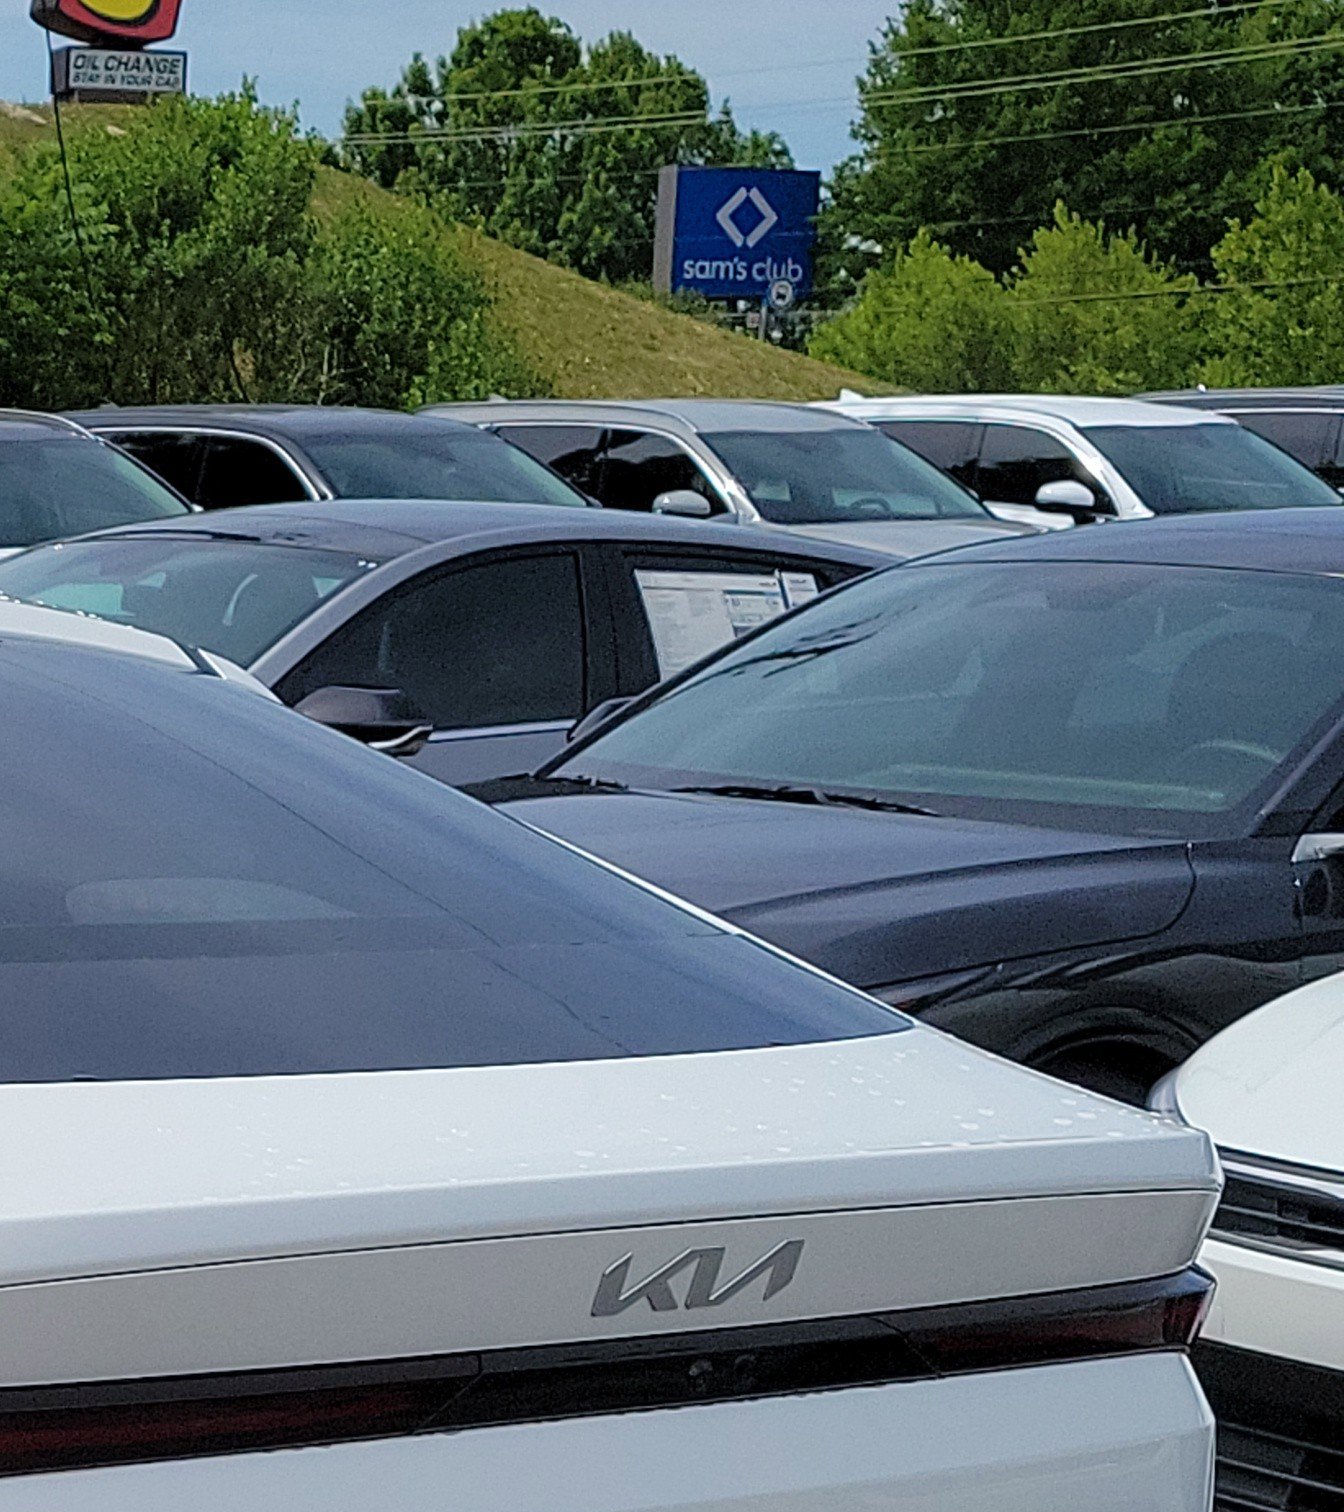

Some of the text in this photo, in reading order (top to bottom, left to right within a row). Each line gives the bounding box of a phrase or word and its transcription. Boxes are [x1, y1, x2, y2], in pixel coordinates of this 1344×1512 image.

[73, 54, 181, 75] OIL CHANGE
[73, 72, 181, 88] STAY IN YOUR CAR
[683, 256, 803, 282] sam's club
[591, 1239, 805, 1317] KIA
